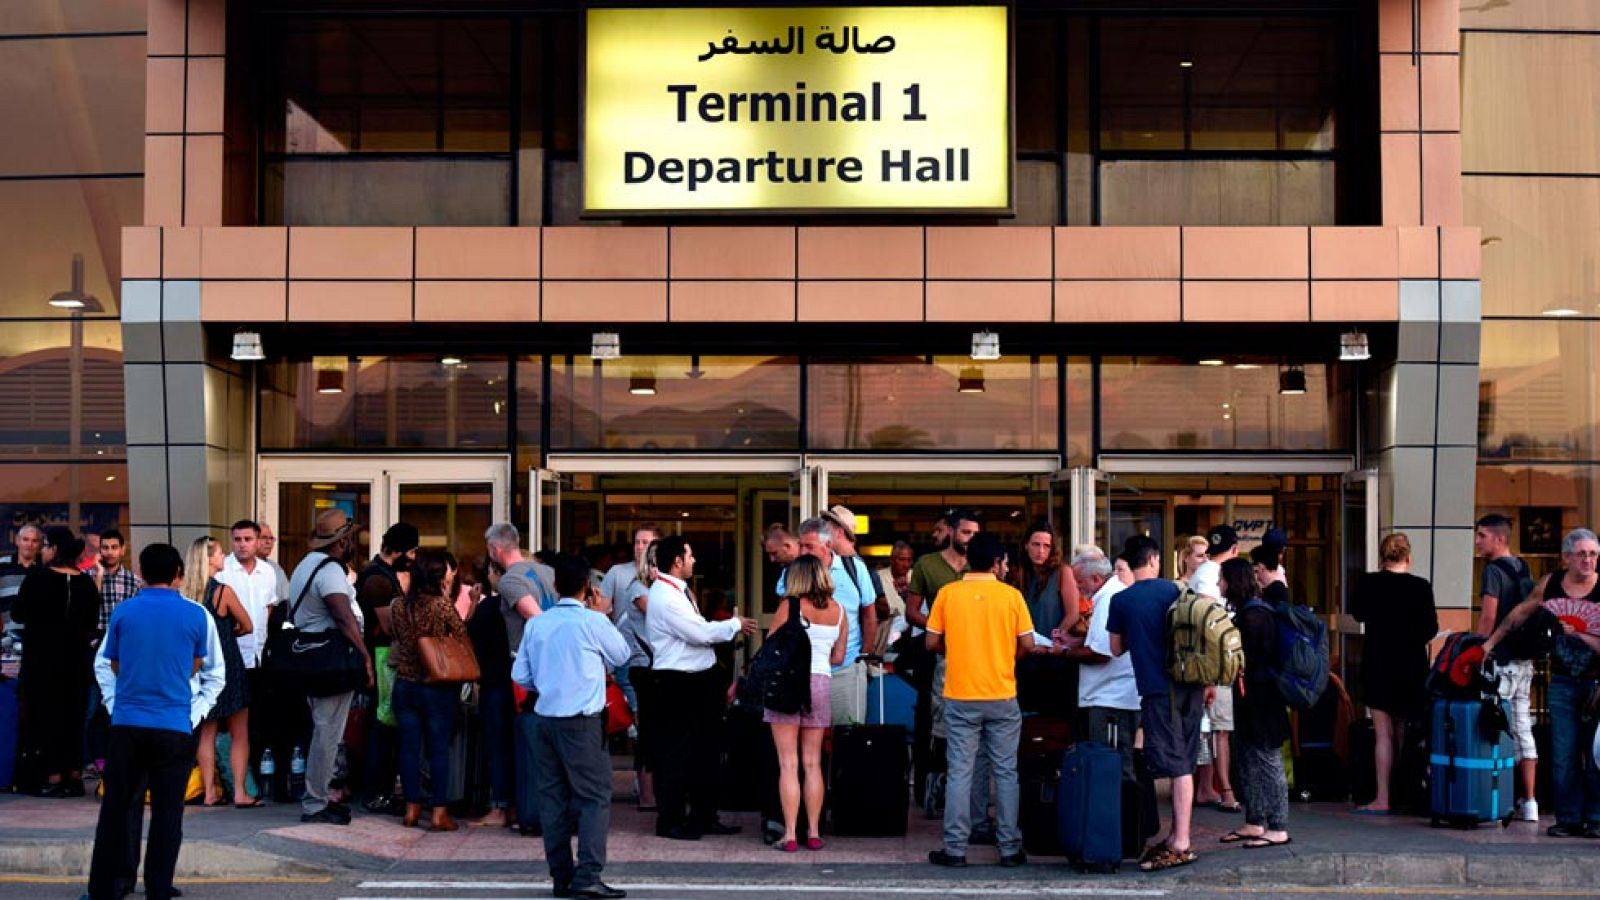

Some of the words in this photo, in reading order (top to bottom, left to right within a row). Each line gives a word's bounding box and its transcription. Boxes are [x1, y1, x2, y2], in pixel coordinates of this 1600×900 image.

[698, 25, 805, 62] السفر
[815, 25, 896, 55] صالة
[667, 81, 881, 122] Terminal
[903, 83, 927, 121] 1
[624, 151, 863, 191] Departure
[881, 148, 969, 182] Hall
